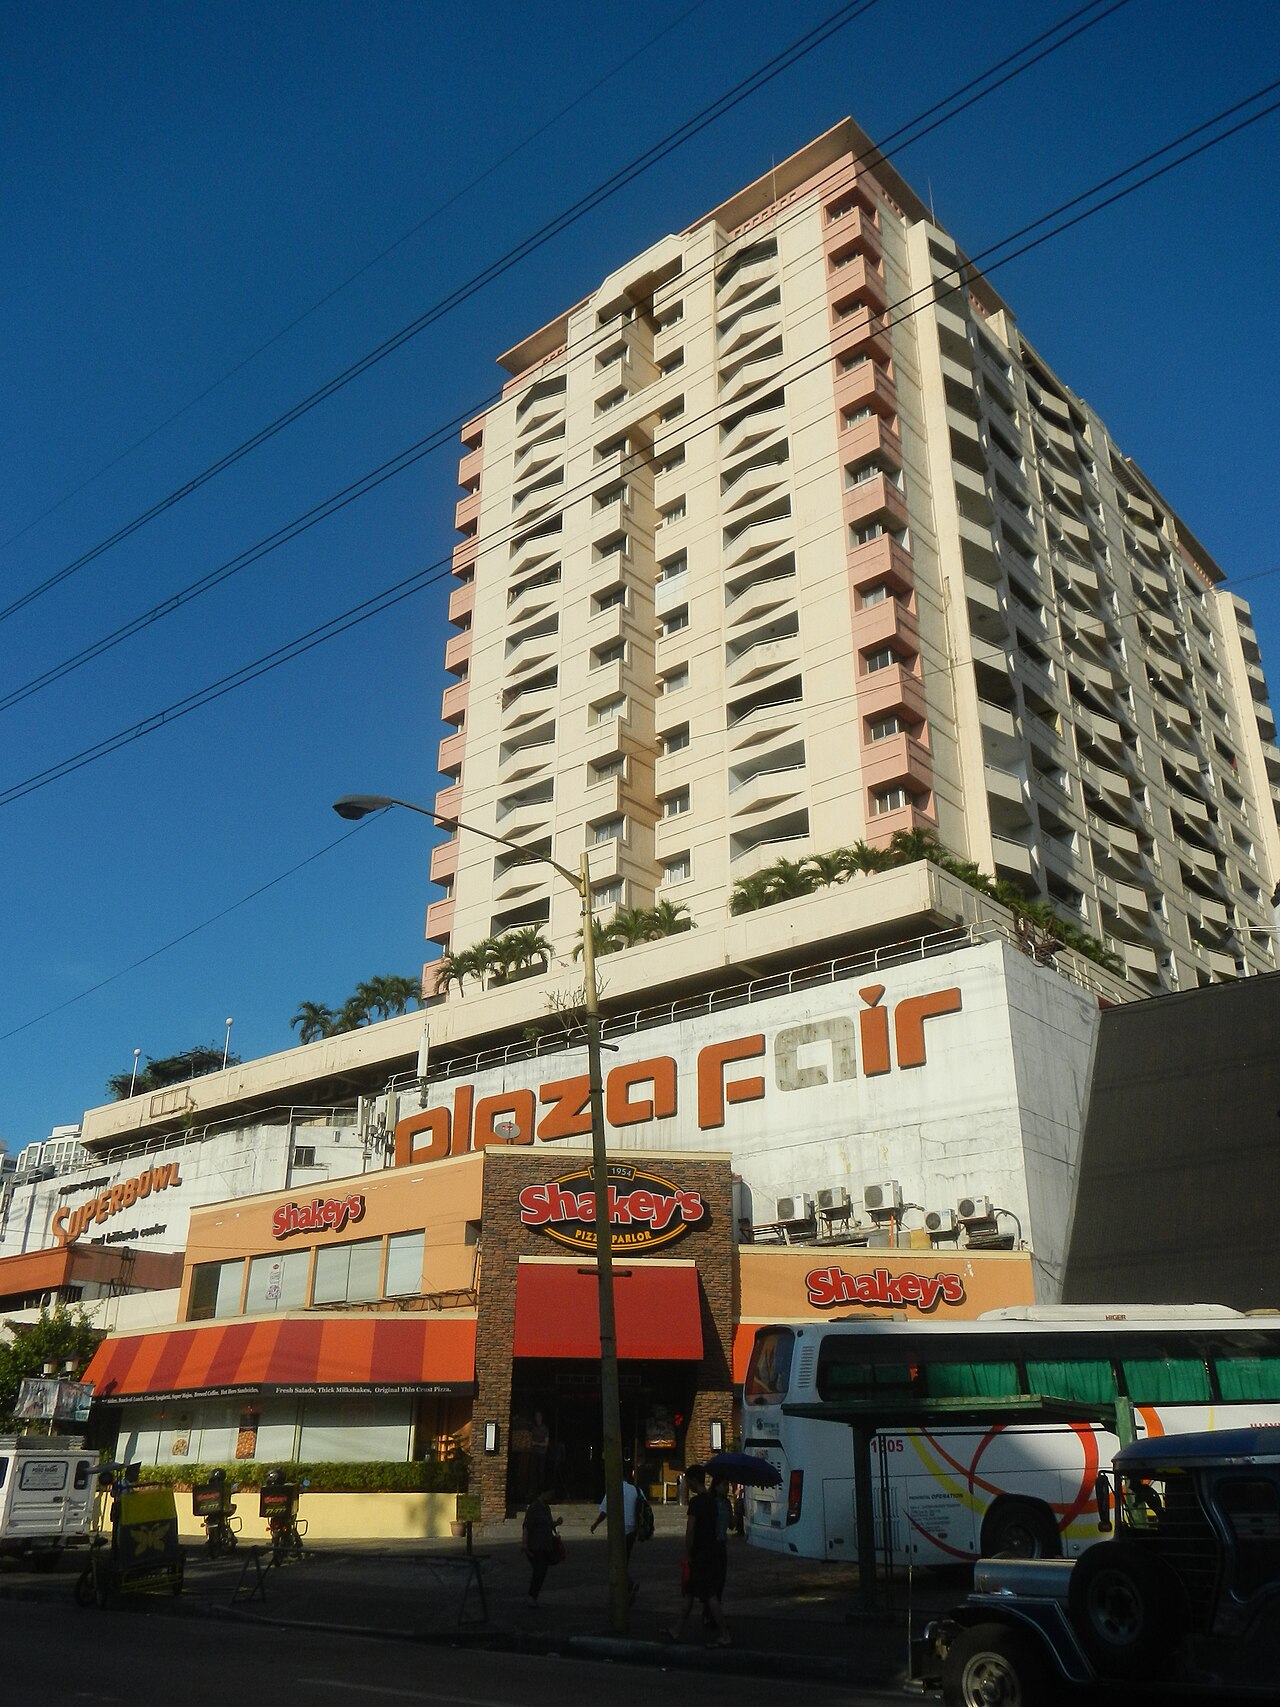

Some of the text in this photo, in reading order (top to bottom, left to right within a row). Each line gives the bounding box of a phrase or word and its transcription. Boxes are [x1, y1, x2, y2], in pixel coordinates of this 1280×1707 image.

[611, 1167, 632, 1177] 1954
[272, 1195, 363, 1238] Shakey's
[519, 1182, 705, 1230] Shakey's
[575, 1229, 652, 1244] PIZZ PARLOR
[806, 1266, 965, 1309] Shakey's
[374, 1386, 400, 1394] Original
